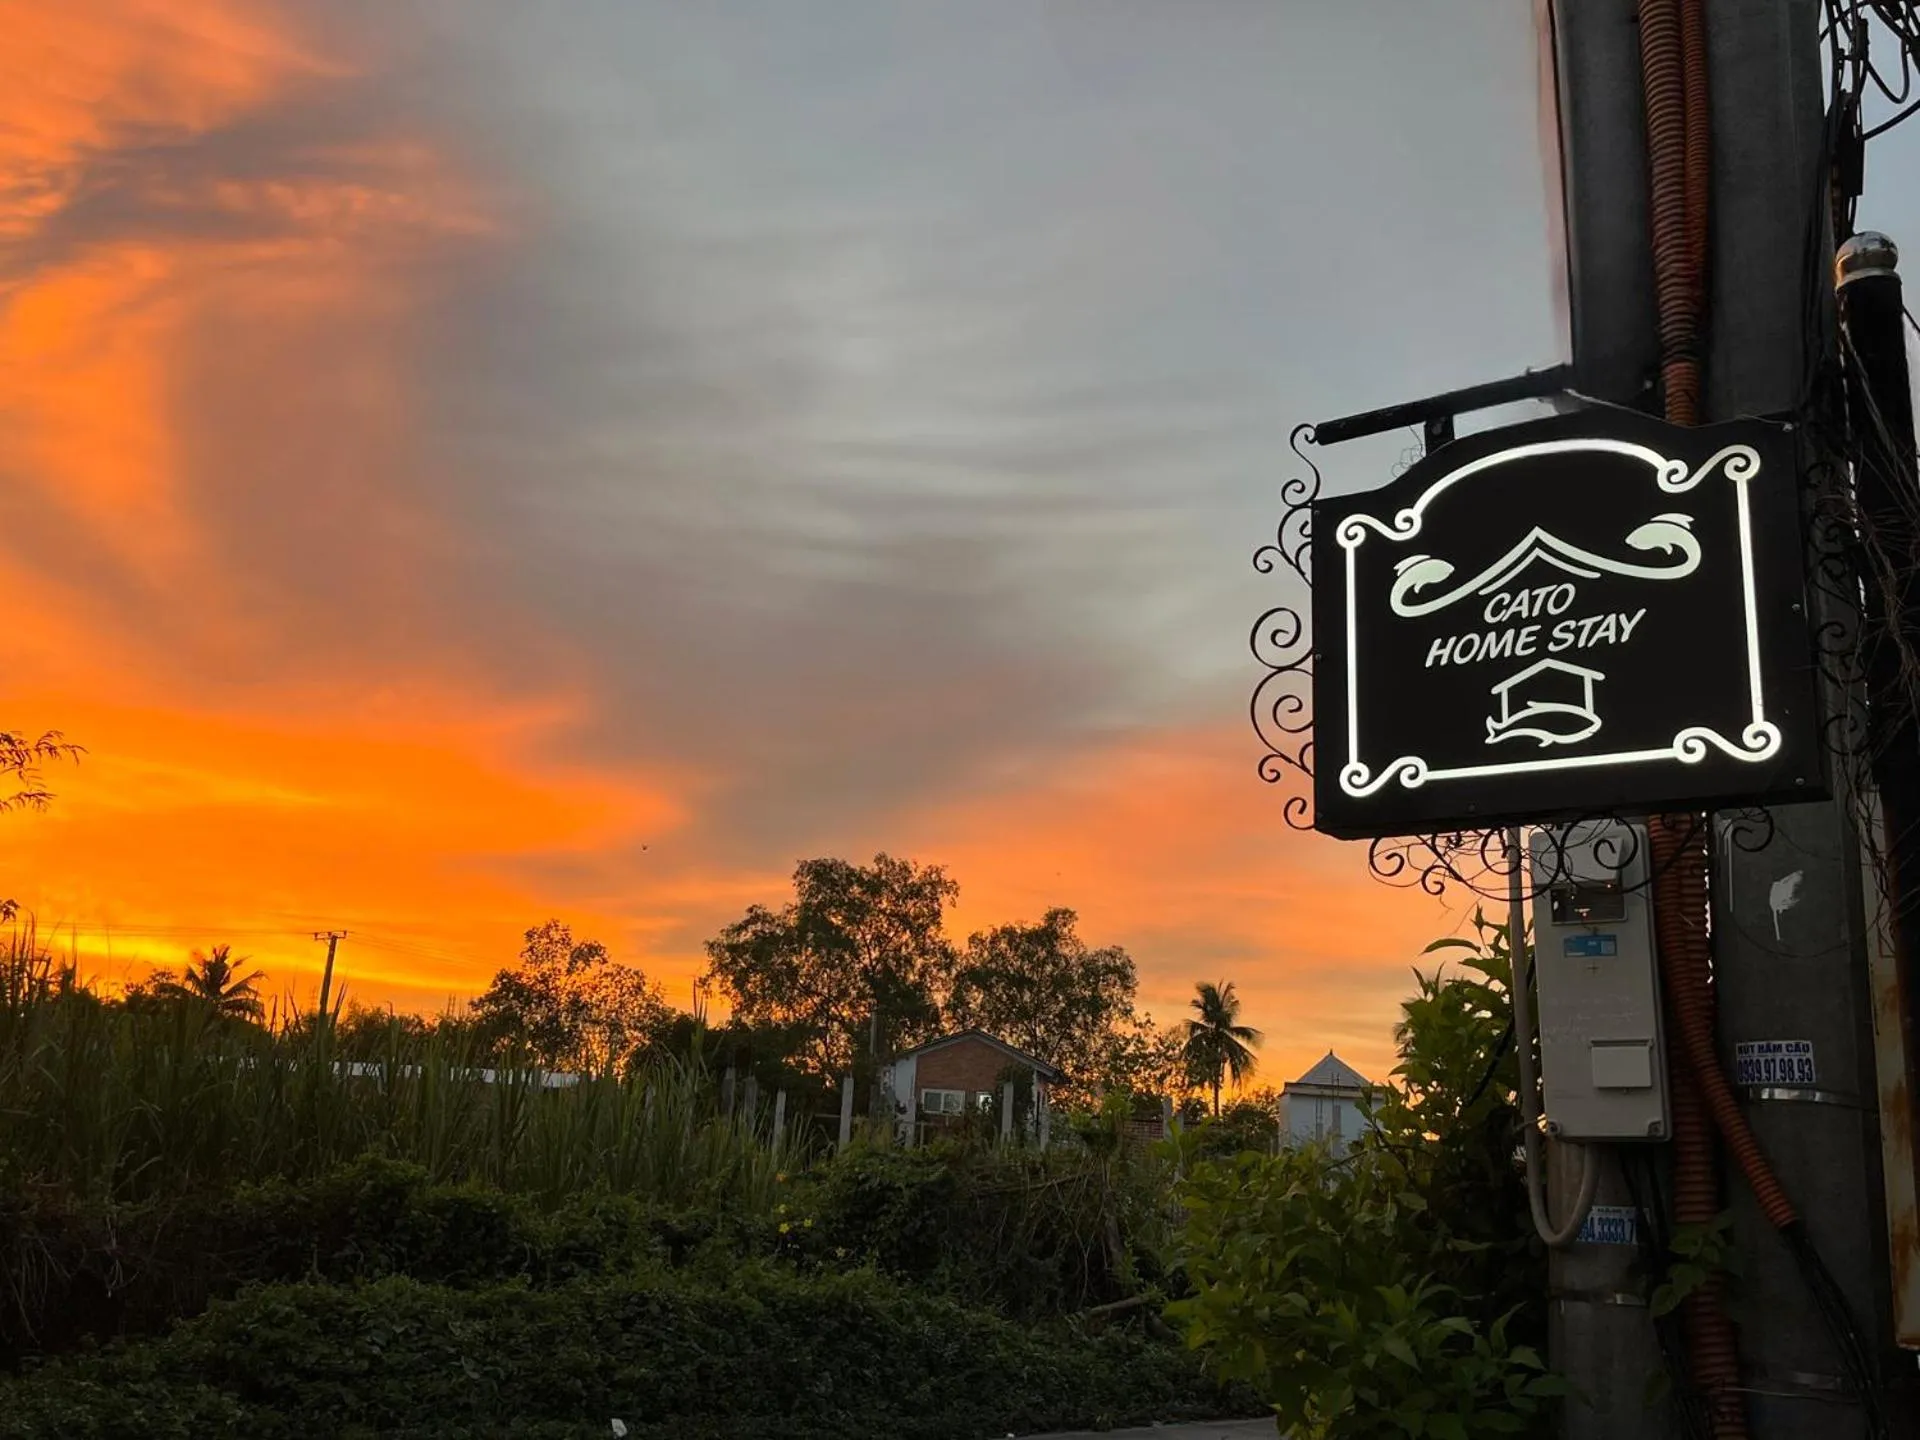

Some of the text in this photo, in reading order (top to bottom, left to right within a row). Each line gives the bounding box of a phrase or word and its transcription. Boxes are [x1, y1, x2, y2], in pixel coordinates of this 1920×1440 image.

[1483, 582, 1577, 624] CATO
[1424, 607, 1648, 668] HOME STAY
